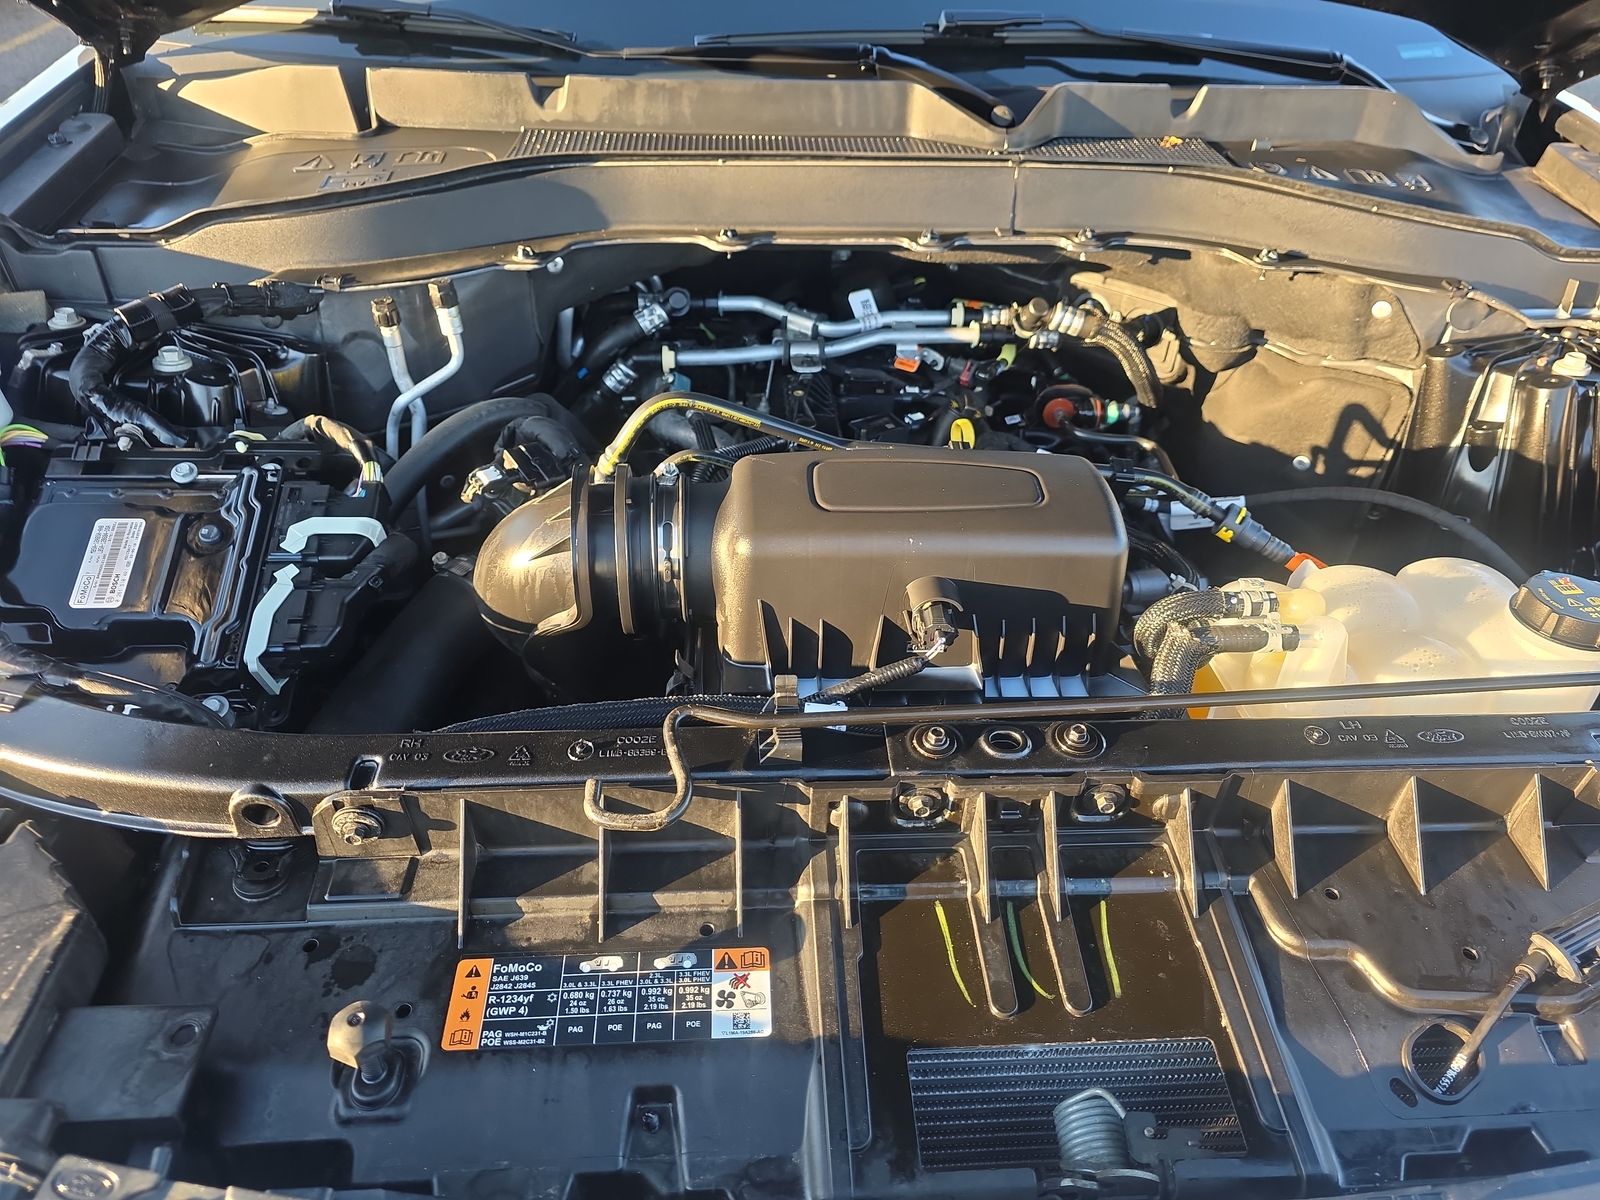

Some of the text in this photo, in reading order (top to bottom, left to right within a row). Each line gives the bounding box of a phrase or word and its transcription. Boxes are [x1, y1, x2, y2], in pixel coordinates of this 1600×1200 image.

[110, 574, 120, 594] BOSCH
[77, 576, 92, 603] FoMoCo
[1339, 720, 1362, 730] LH
[1337, 734, 1378, 742] CAV 03
[400, 738, 422, 748] RH
[389, 752, 410, 761] CAV
[493, 962, 542, 973] FoMoCo
[623, 990, 632, 998] kg
[663, 987, 673, 996] kg
[700, 986, 710, 994] kg
[488, 994, 534, 1004] R-1234yf
[585, 991, 594, 1000] kg
[486, 1006, 528, 1017] (GWP 4)
[481, 1038, 501, 1046] POE
